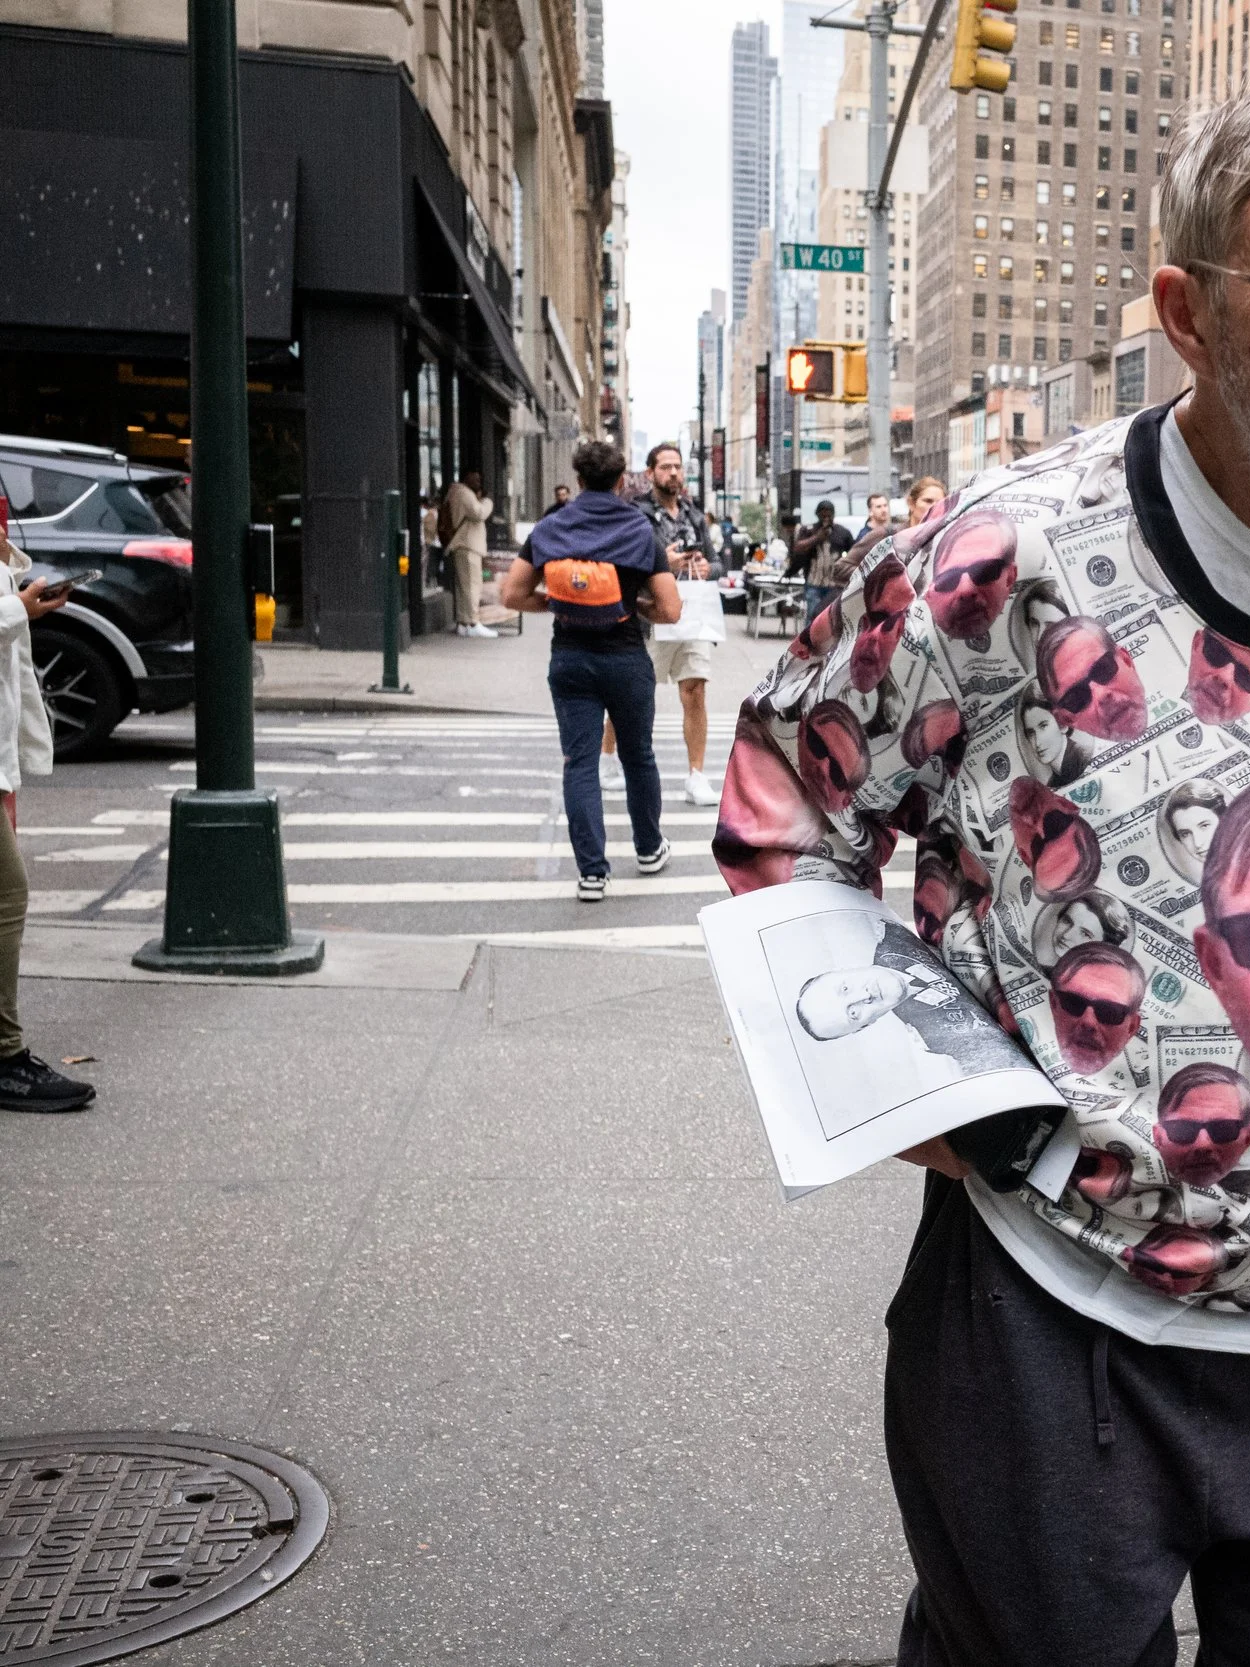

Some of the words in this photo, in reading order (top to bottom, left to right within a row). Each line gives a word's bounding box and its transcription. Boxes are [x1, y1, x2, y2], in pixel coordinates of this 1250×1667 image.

[799, 246, 813, 267] W
[818, 248, 843, 269] 40
[848, 250, 861, 260] ST
